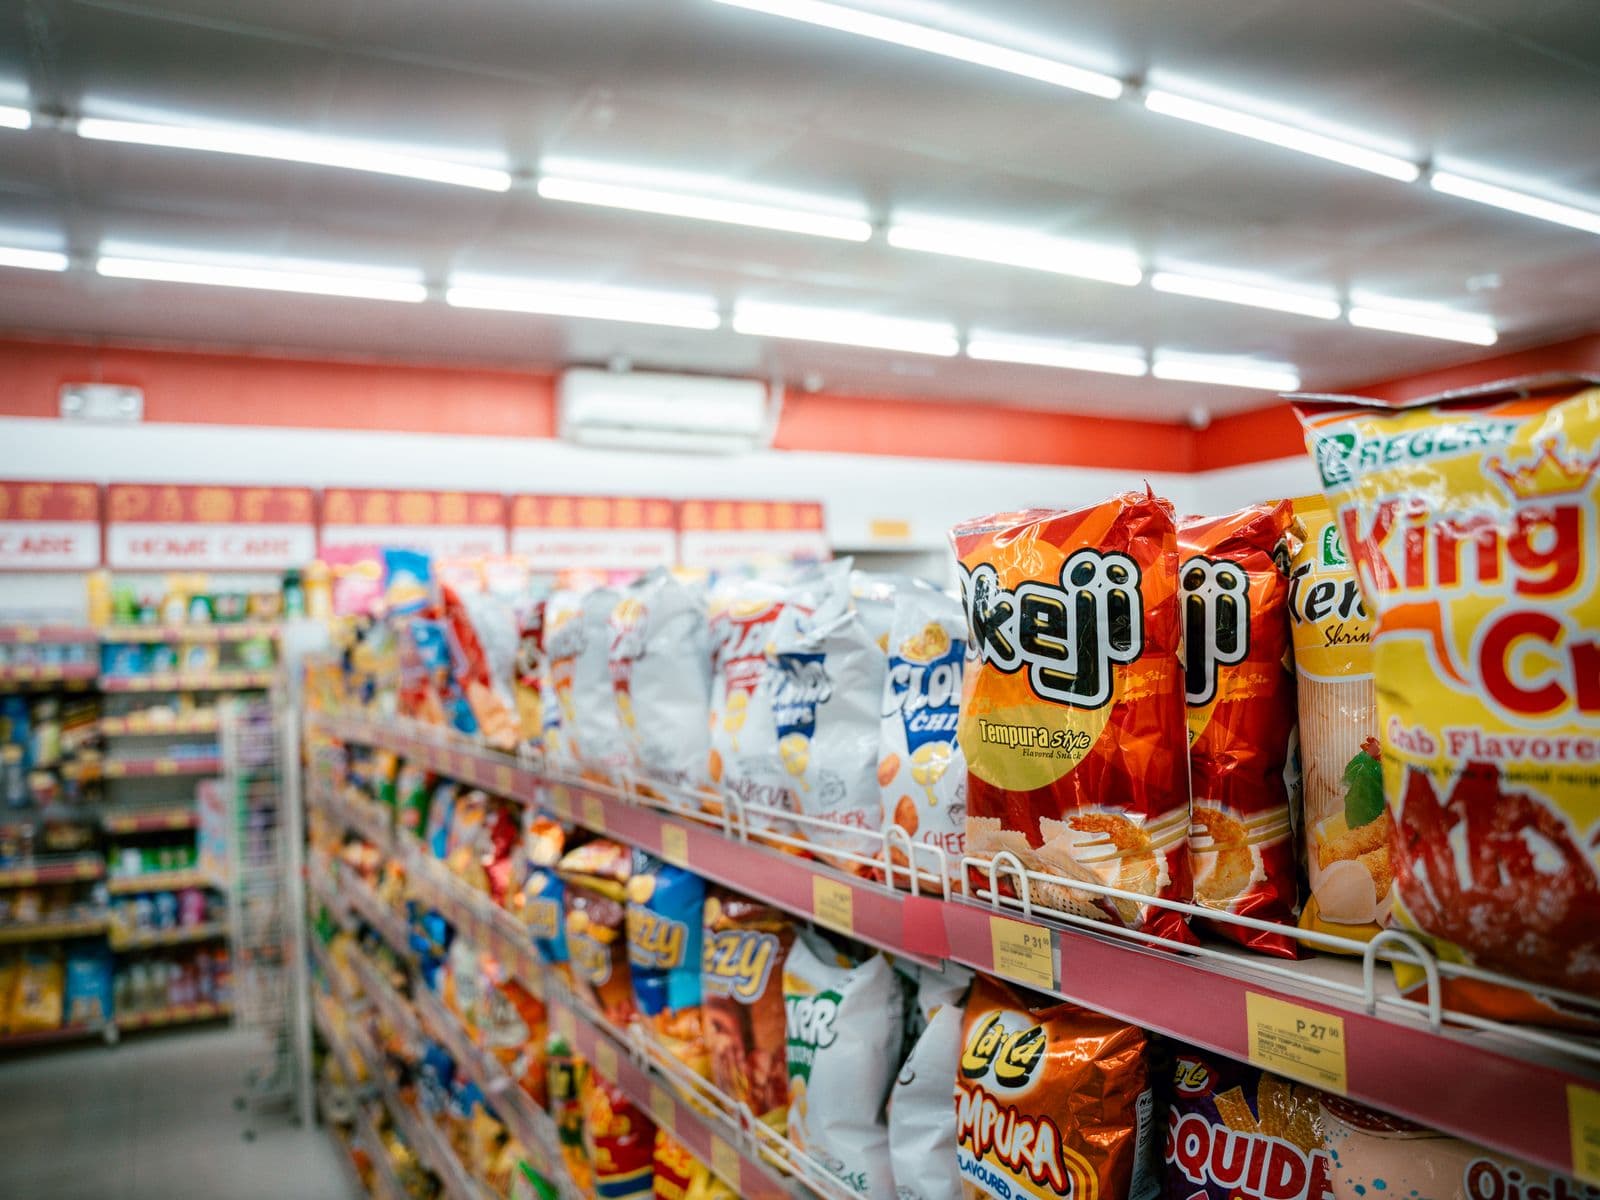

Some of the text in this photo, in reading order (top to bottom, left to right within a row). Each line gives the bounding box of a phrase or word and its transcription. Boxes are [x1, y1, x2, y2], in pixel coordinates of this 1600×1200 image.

[1341, 496, 1582, 596] King
[957, 547, 1145, 710] keji
[908, 711, 959, 732] CHI
[979, 718, 1092, 754] Tempura Style
[1022, 748, 1083, 760] Flavored Snack
[1447, 730, 1600, 762] Flavore
[923, 830, 966, 856] CHEE
[1296, 1020, 1306, 1033] P
[1310, 1024, 1327, 1040] 27
[955, 1083, 1070, 1196] MPURA
